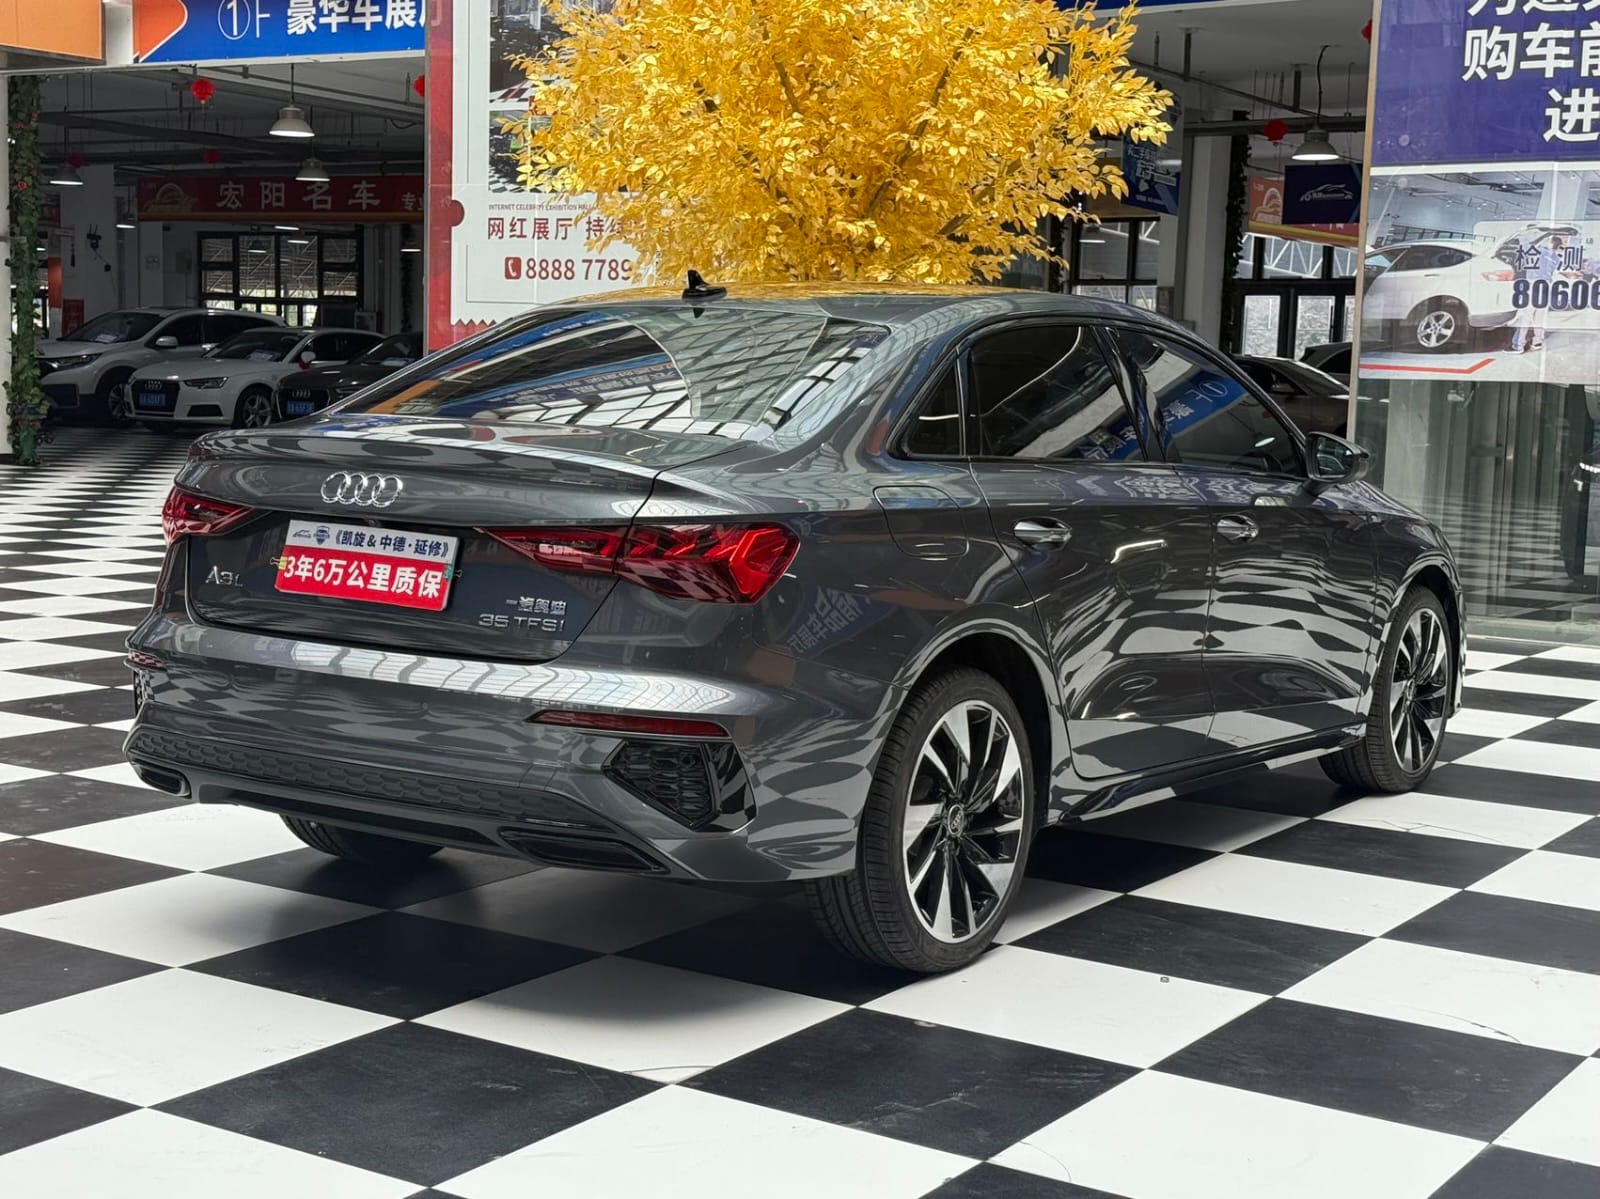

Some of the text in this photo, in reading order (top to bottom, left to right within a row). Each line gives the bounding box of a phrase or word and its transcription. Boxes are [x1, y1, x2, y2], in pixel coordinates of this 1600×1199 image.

[1543, 88, 1600, 142] 进
[215, 180, 381, 210] 宏阳名车
[487, 217, 573, 240] 网红展厅
[526, 258, 632, 281] 8888 7789
[1515, 244, 1584, 271] 检测
[205, 565, 243, 587] A3L
[284, 555, 443, 599] 3年6万公里质保
[479, 613, 565, 632] 35 TFSI
